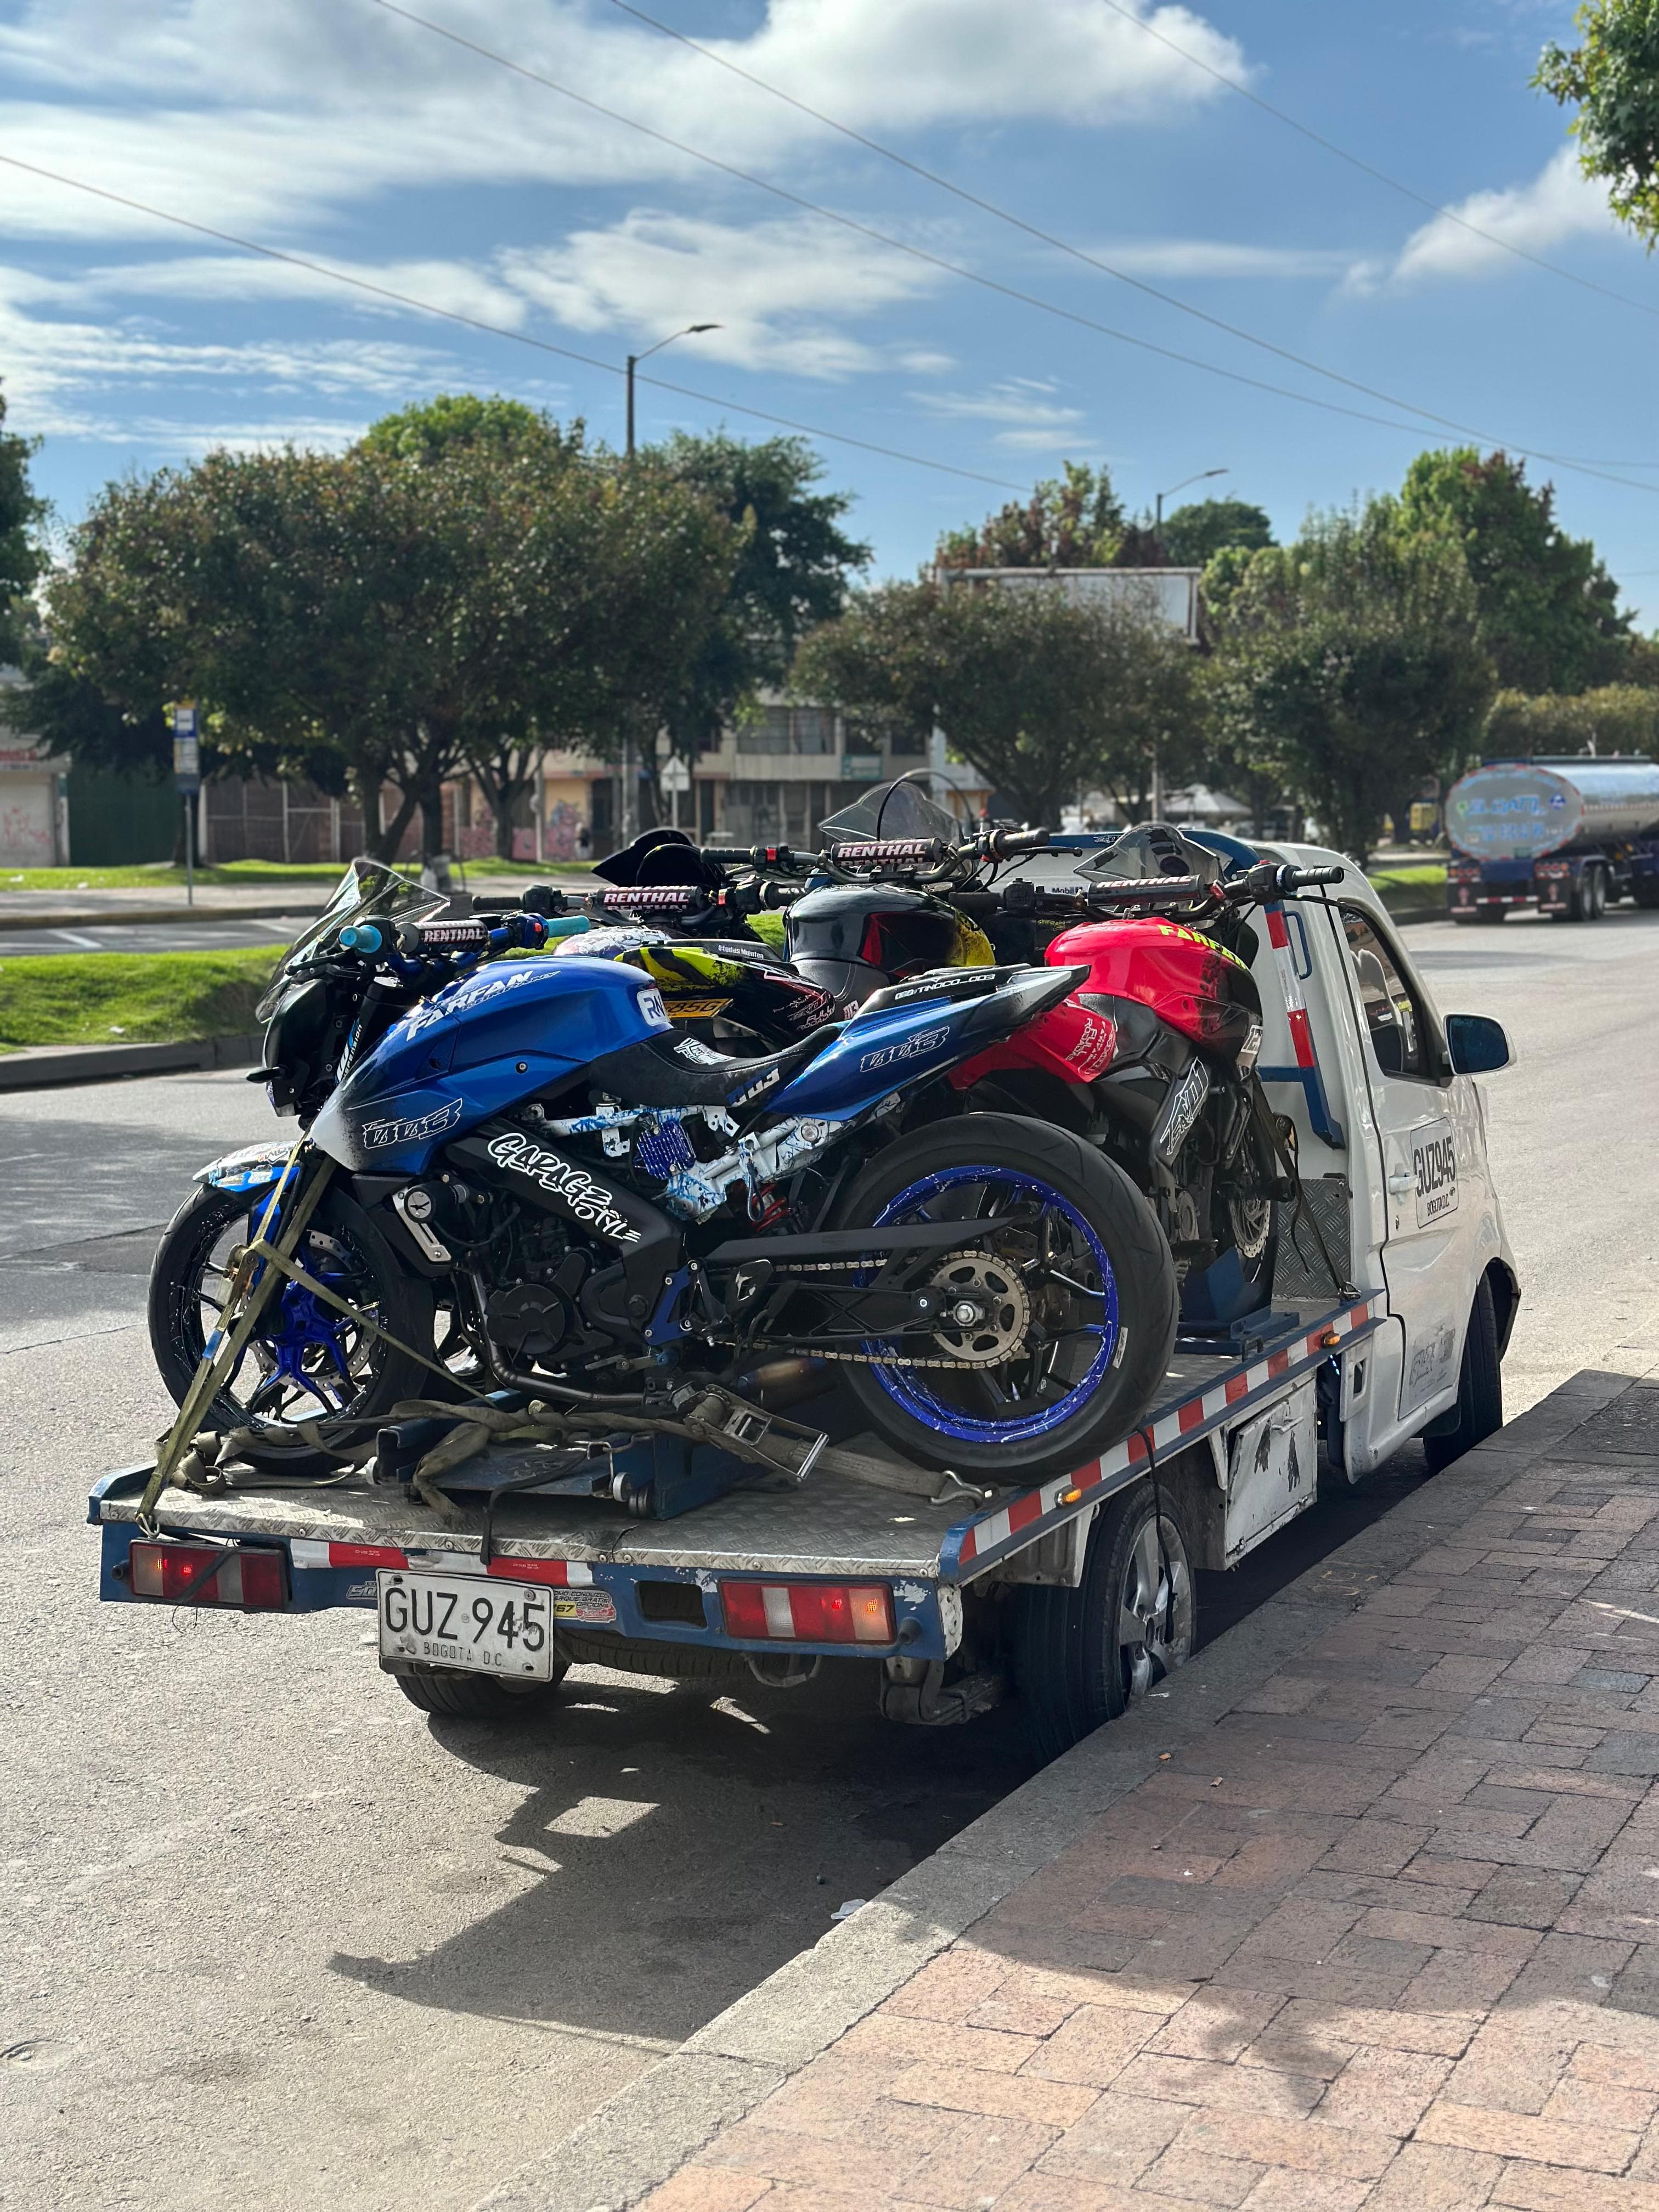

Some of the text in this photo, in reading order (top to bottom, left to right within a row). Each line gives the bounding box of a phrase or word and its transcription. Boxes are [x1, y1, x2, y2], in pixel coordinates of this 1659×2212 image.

[838, 844, 925, 857] RENTHAL
[1097, 876, 1195, 888] RENTHAL
[603, 892, 689, 903] RENTHAL
[424, 928, 484, 943] RENTHAL
[407, 970, 533, 1041] FARFAN
[1413, 1136, 1456, 1197] GUZ945
[554, 1604, 575, 1612] 67
[385, 1587, 545, 1652] GUZ 945
[424, 1641, 473, 1661] BOGOTA
